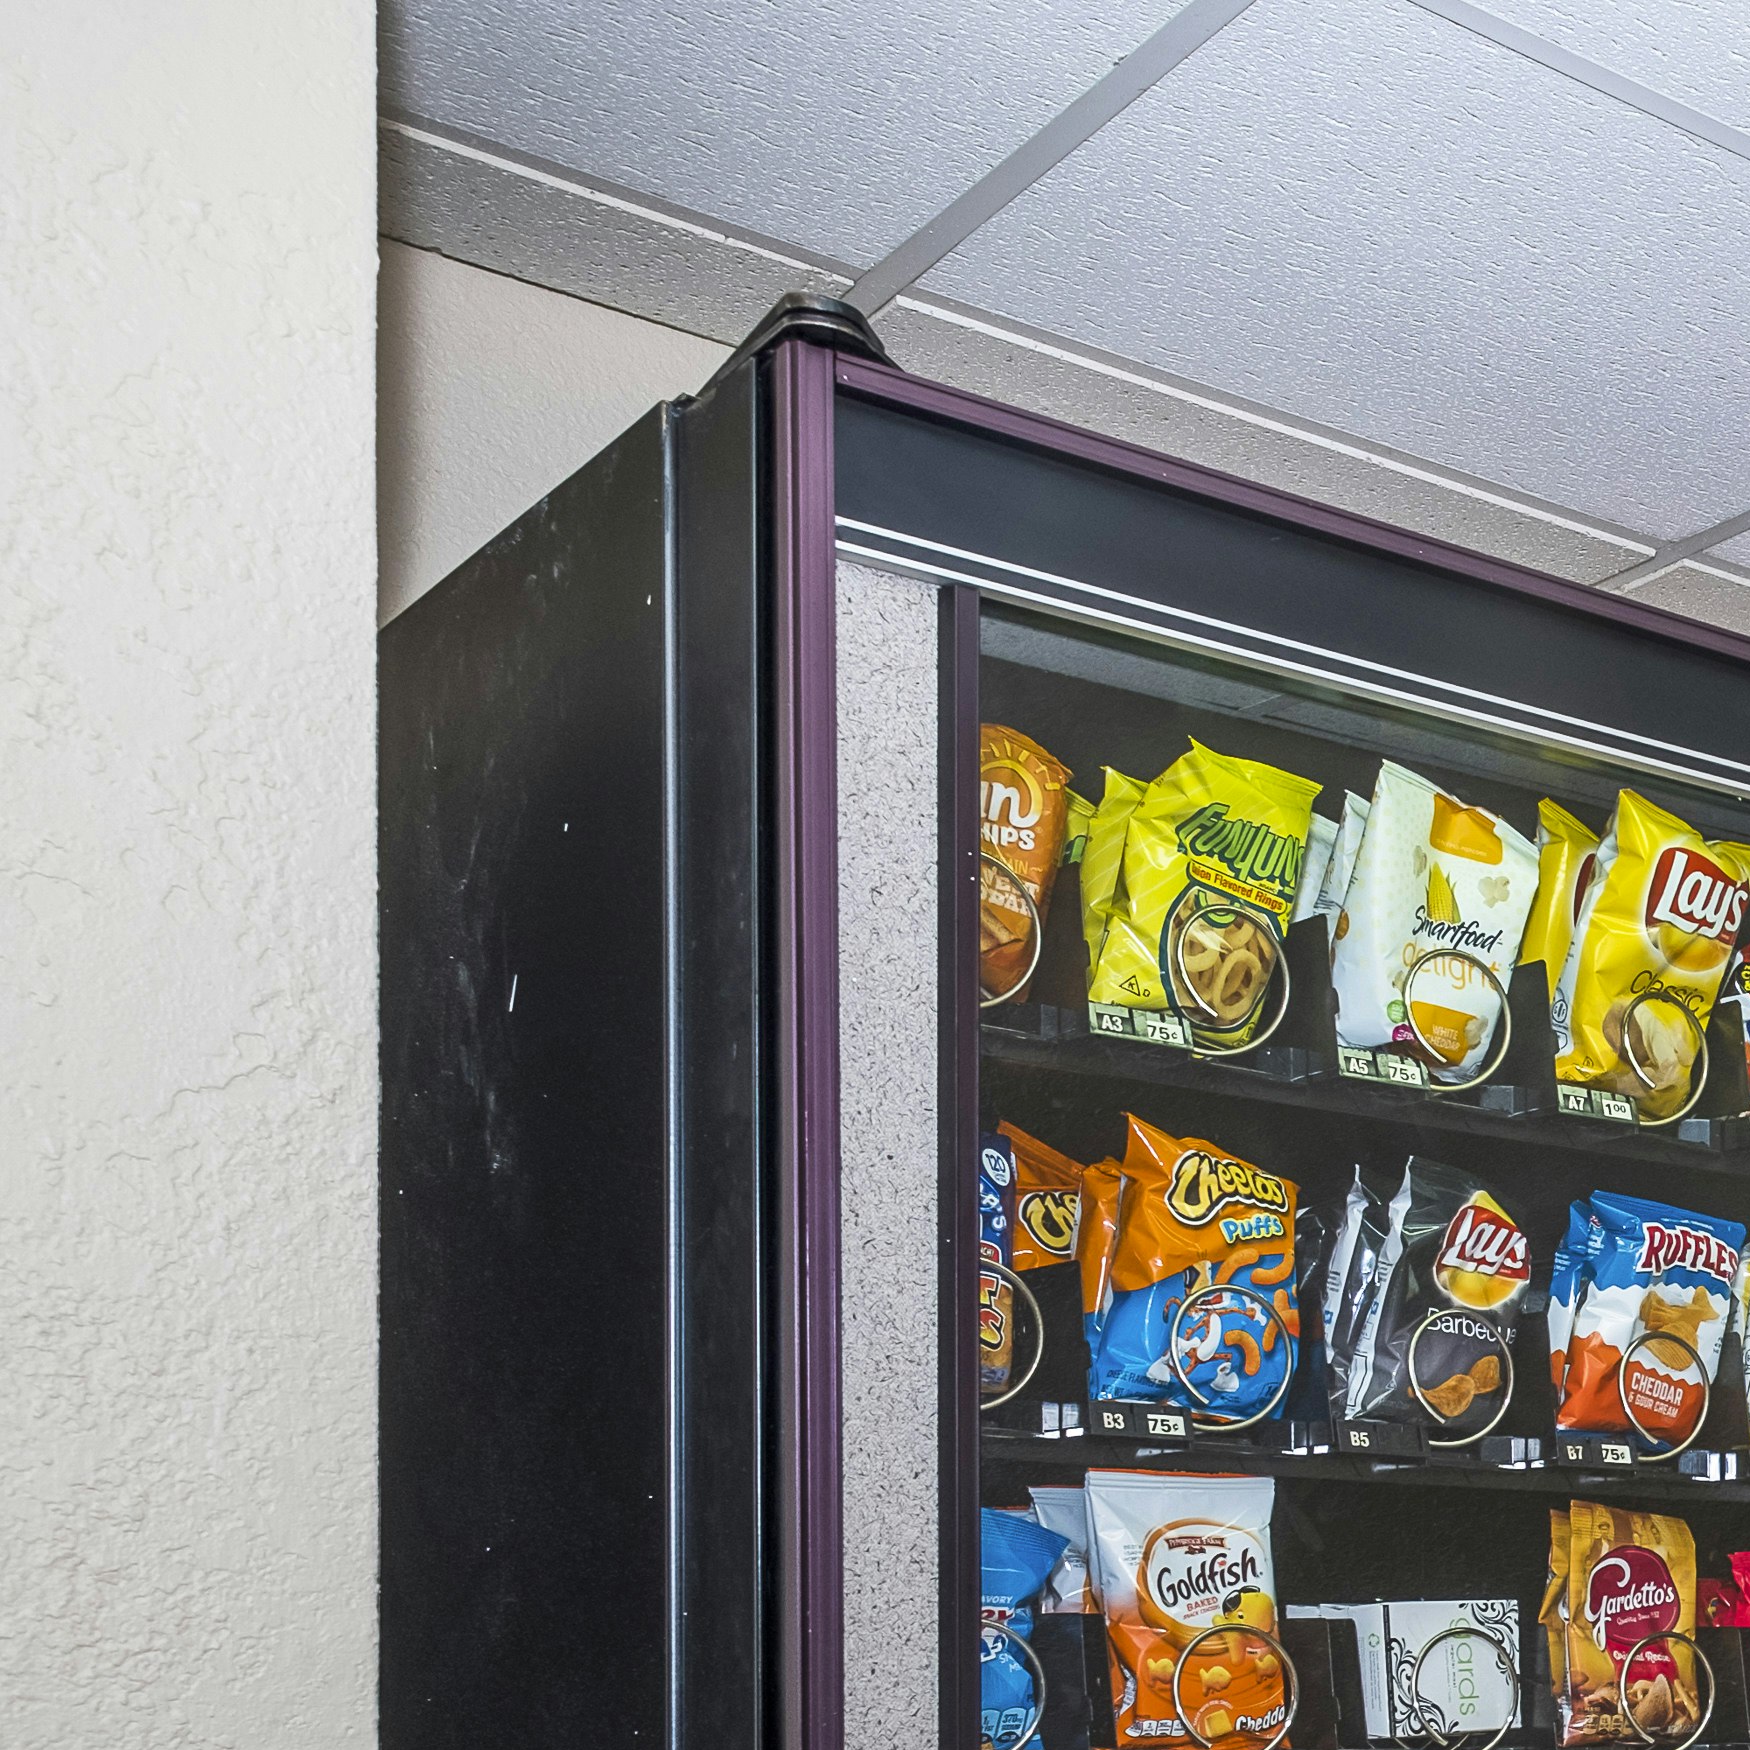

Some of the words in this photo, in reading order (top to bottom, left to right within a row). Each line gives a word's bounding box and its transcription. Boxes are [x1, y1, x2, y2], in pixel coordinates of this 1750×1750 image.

[1213, 873, 1253, 898] Flavored
[1254, 891, 1284, 911] Rings
[1652, 850, 1749, 940] Lay's
[1412, 904, 1500, 953] Smartfood
[1630, 968, 1704, 1013] Classic
[1101, 1015, 1123, 1032] A3
[1349, 1058, 1368, 1075] A5
[1568, 1095, 1585, 1111] A7
[1169, 1152, 1286, 1222] Cheetos
[1223, 1214, 1284, 1243] Puffs
[1636, 1222, 1739, 1284] RUFFLES
[1631, 1372, 1684, 1406] CHEDDAR
[1103, 1412, 1125, 1430] B3
[1635, 1395, 1653, 1410] SOUR
[1654, 1398, 1679, 1419] CREAM
[1350, 1431, 1370, 1447] B5
[1567, 1445, 1583, 1460] B7
[1157, 1547, 1259, 1608] Goldfish
[1186, 1596, 1219, 1611] BAKED
[1584, 1557, 1675, 1651] Gardetto's
[1236, 1705, 1285, 1732] Chedda
